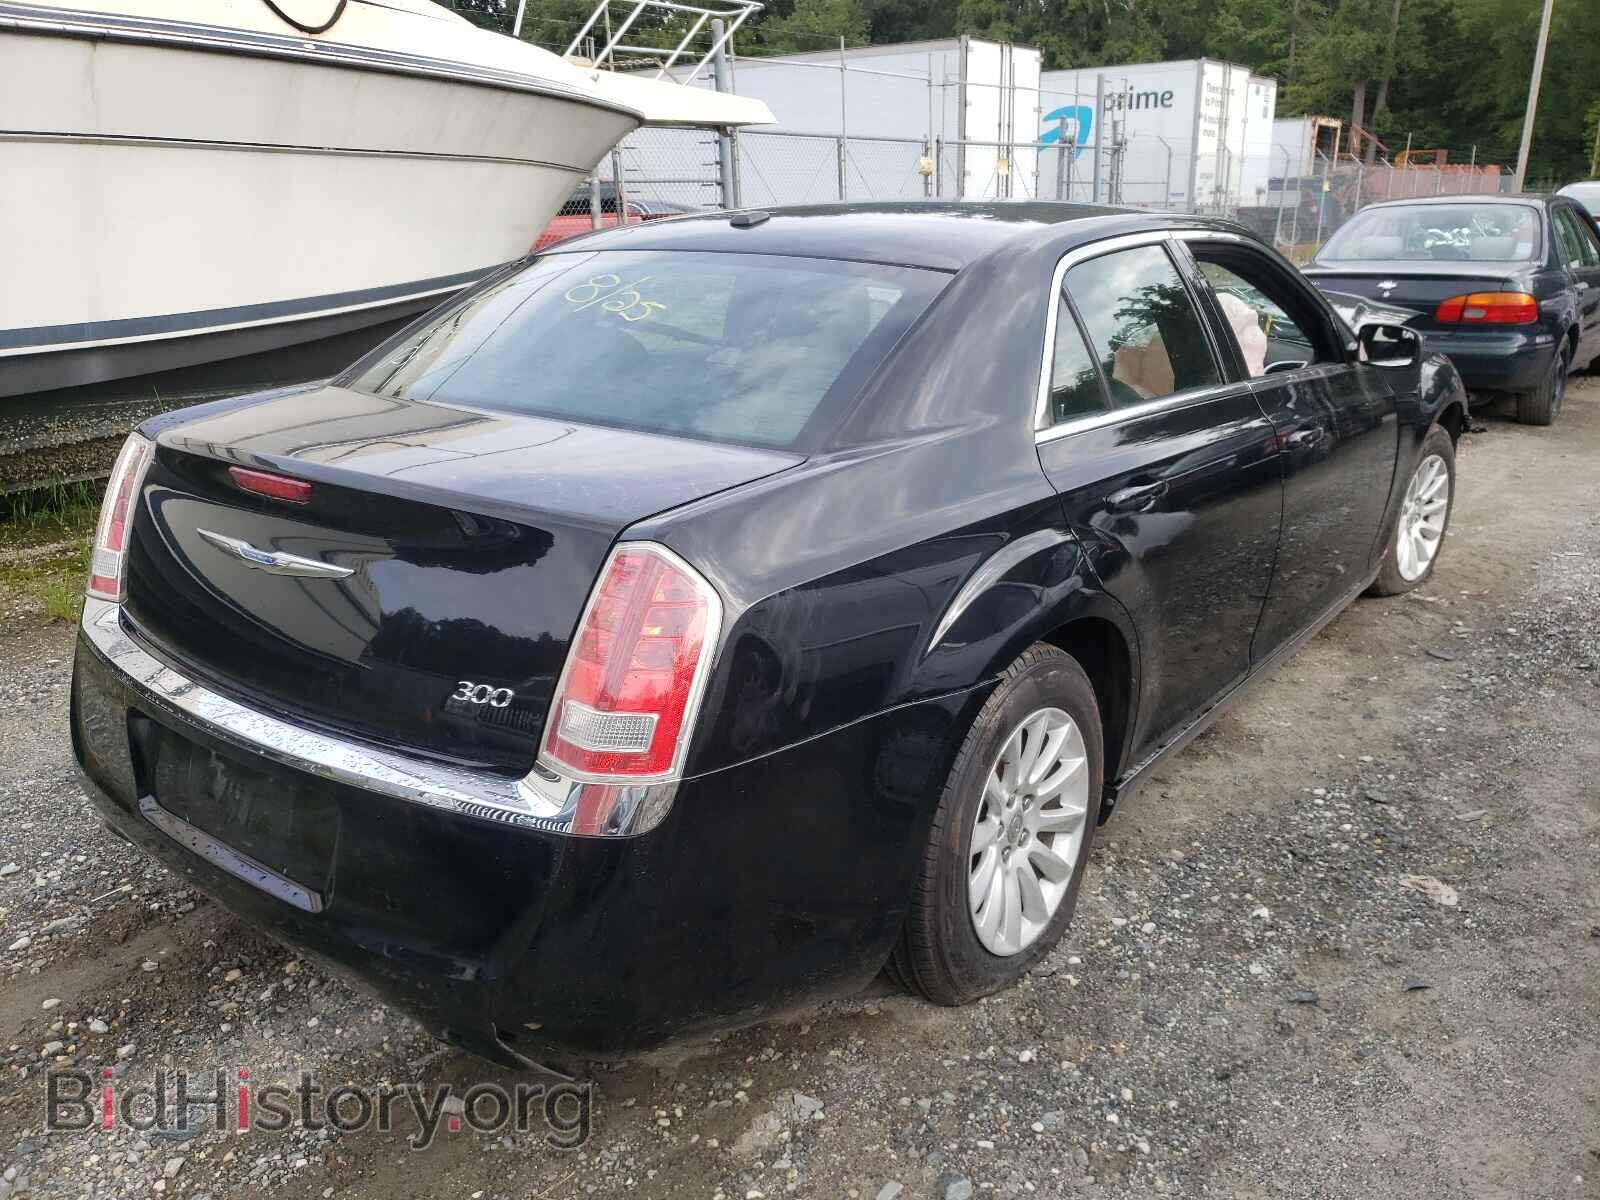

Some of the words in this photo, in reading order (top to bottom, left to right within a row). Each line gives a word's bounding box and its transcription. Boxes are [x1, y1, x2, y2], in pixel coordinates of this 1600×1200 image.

[1104, 86, 1174, 115] prime
[565, 274, 666, 321] 8/25
[452, 681, 515, 708] 300
